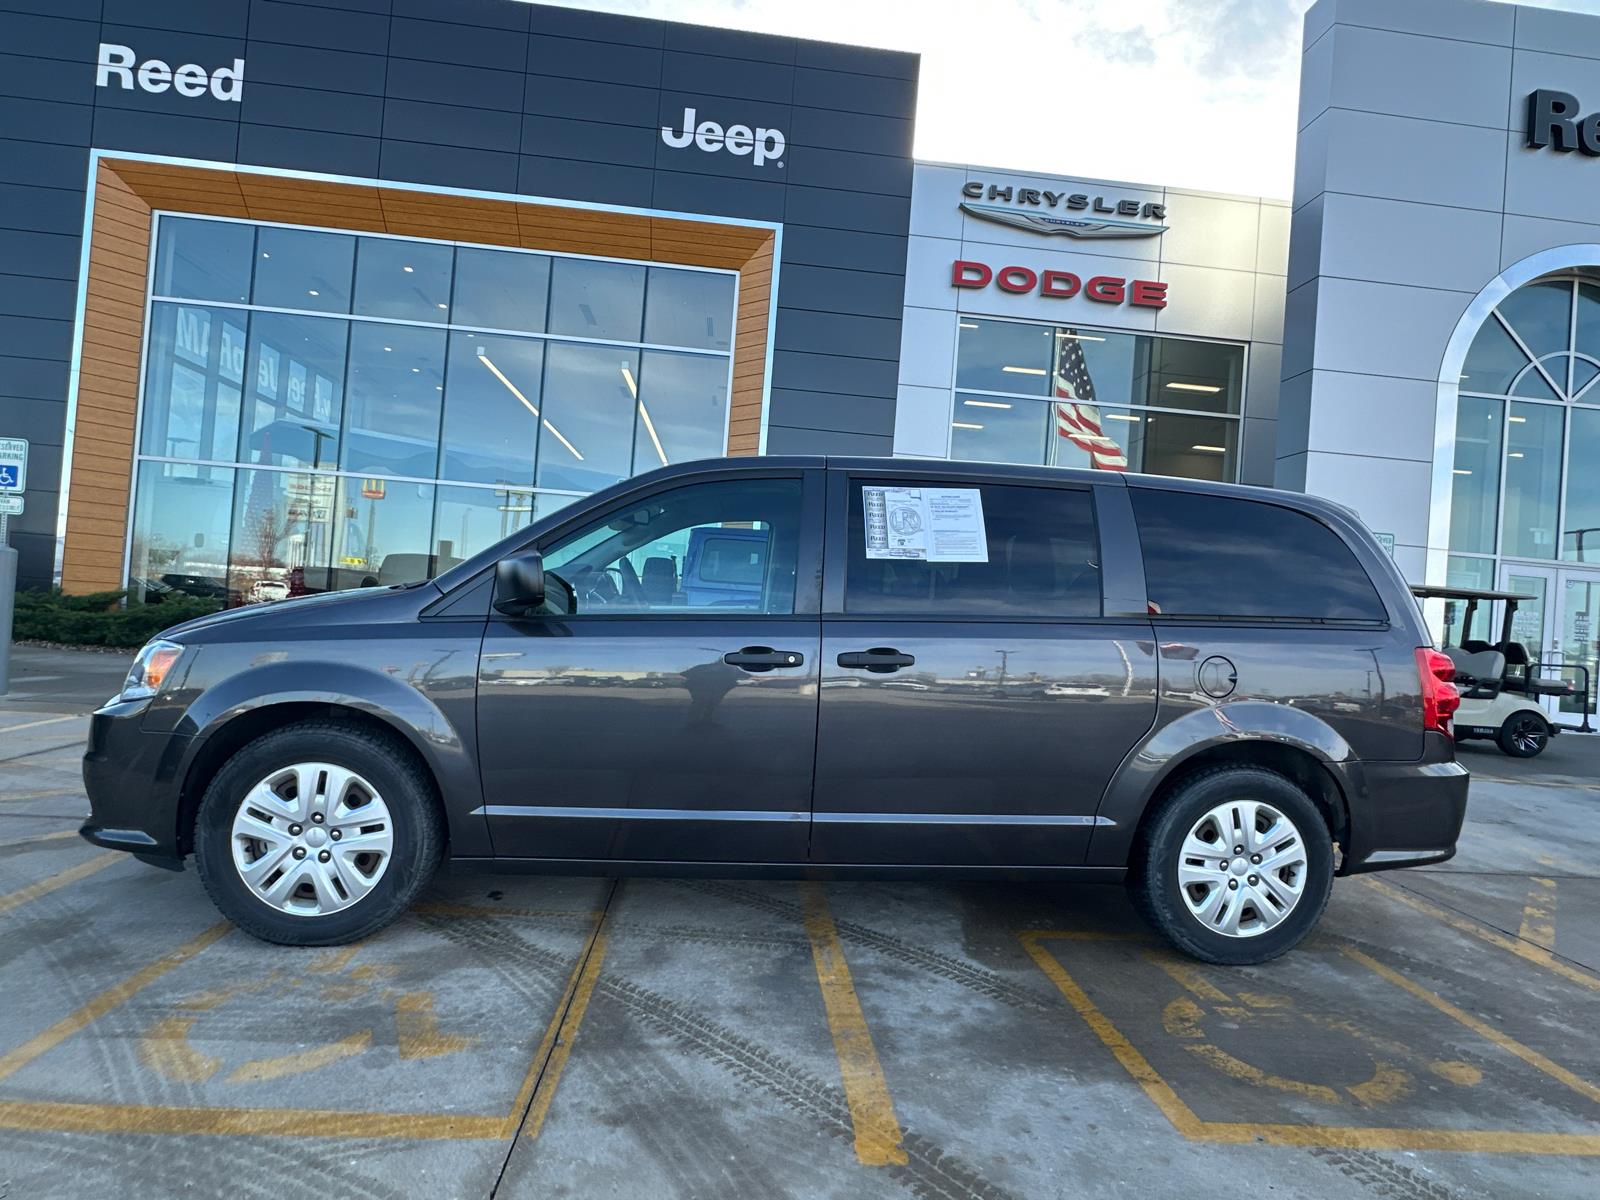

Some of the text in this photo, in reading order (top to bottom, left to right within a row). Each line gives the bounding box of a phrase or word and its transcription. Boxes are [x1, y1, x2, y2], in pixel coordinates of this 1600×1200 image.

[96, 43, 245, 102] Reed
[661, 107, 785, 167] Jeep
[962, 182, 1167, 219] CHRYSLER
[952, 260, 1168, 309] DODGE
[0, 442, 24, 452] SERVED
